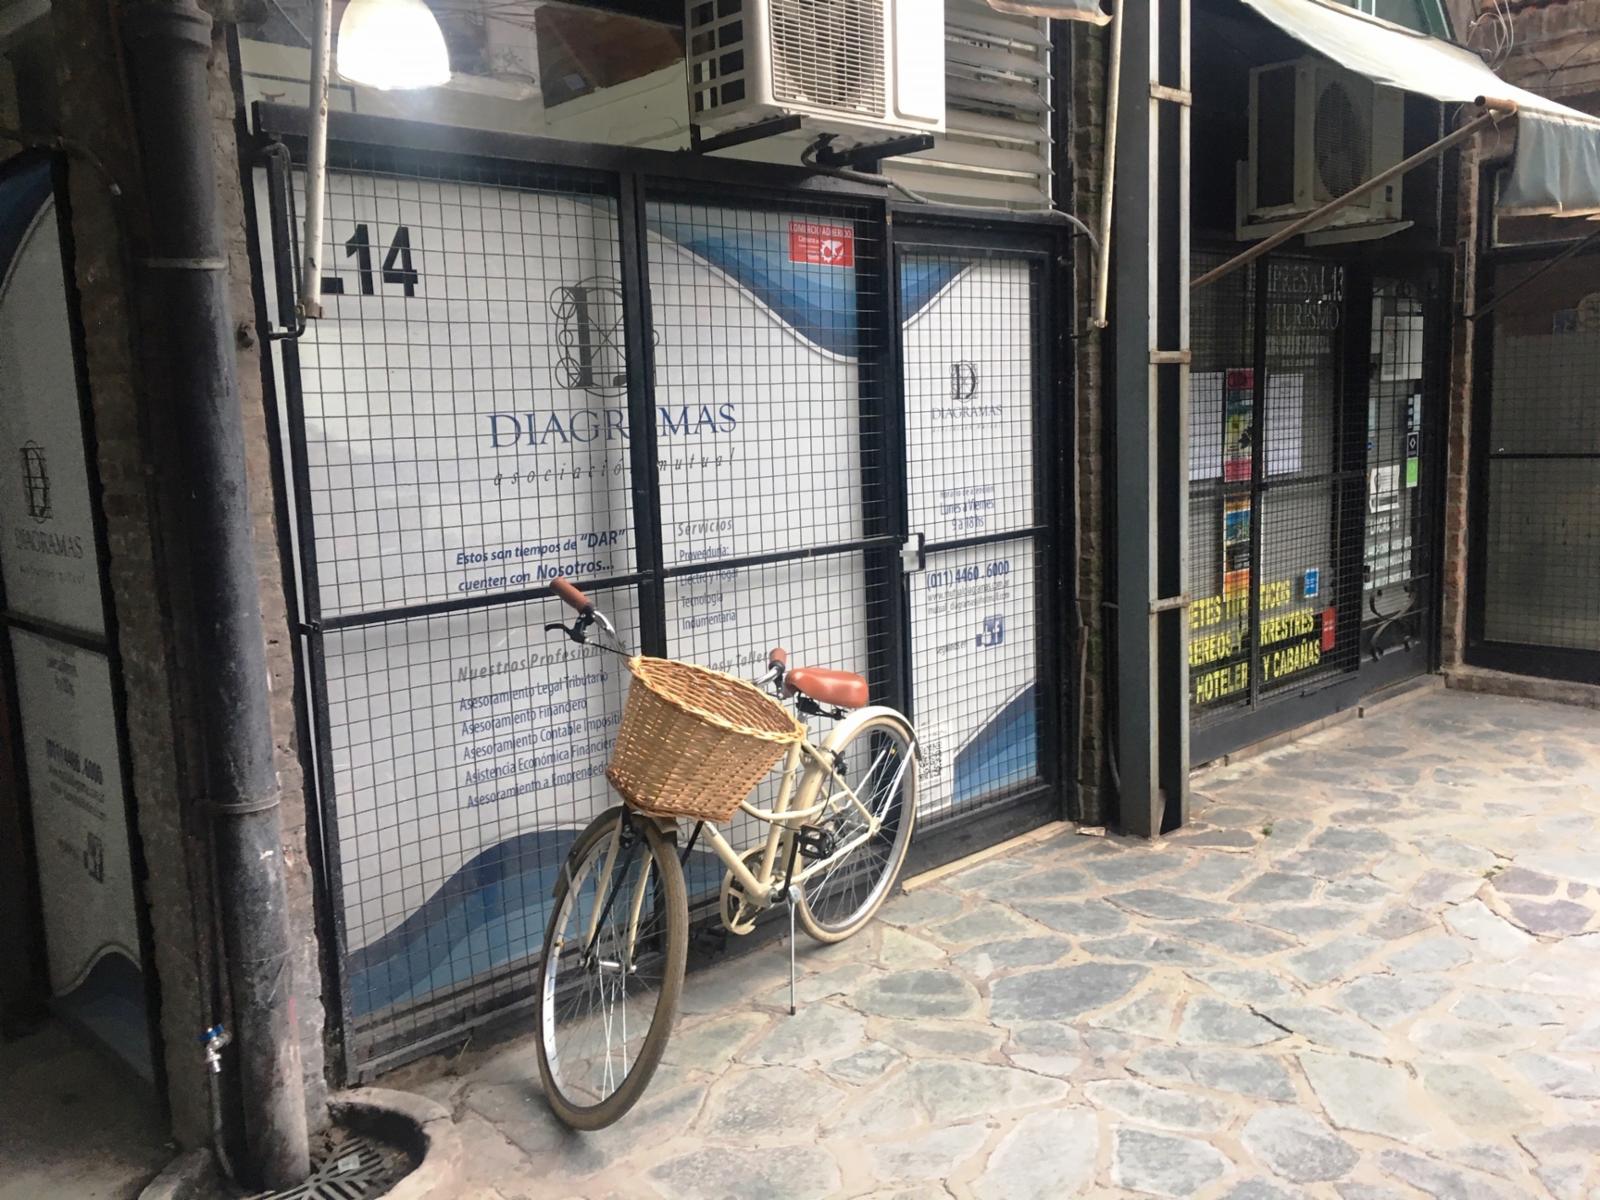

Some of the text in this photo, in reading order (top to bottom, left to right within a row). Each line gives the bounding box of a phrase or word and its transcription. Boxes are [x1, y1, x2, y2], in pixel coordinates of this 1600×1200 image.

[488, 403, 737, 448] DIAGRMAS
[494, 458, 628, 486] asociació
[678, 519, 732, 537] Servicios
[456, 551, 489, 565] Estos
[490, 549, 512, 561] son
[514, 542, 561, 559] tiempos
[563, 538, 578, 551] de
[458, 576, 507, 592] cuenten
[510, 572, 531, 585] con
[927, 570, 953, 592] (011)
[458, 659, 527, 682] Nuestros
[460, 671, 609, 711] Asesoramiento Legal Tributario
[462, 708, 537, 737] Asesoramiento
[463, 733, 538, 761] Asesoramiento
[540, 722, 582, 742] Contable
[465, 762, 516, 786] Asistencia
[518, 749, 569, 772] Económica
[467, 779, 541, 808] Asesoramiento
